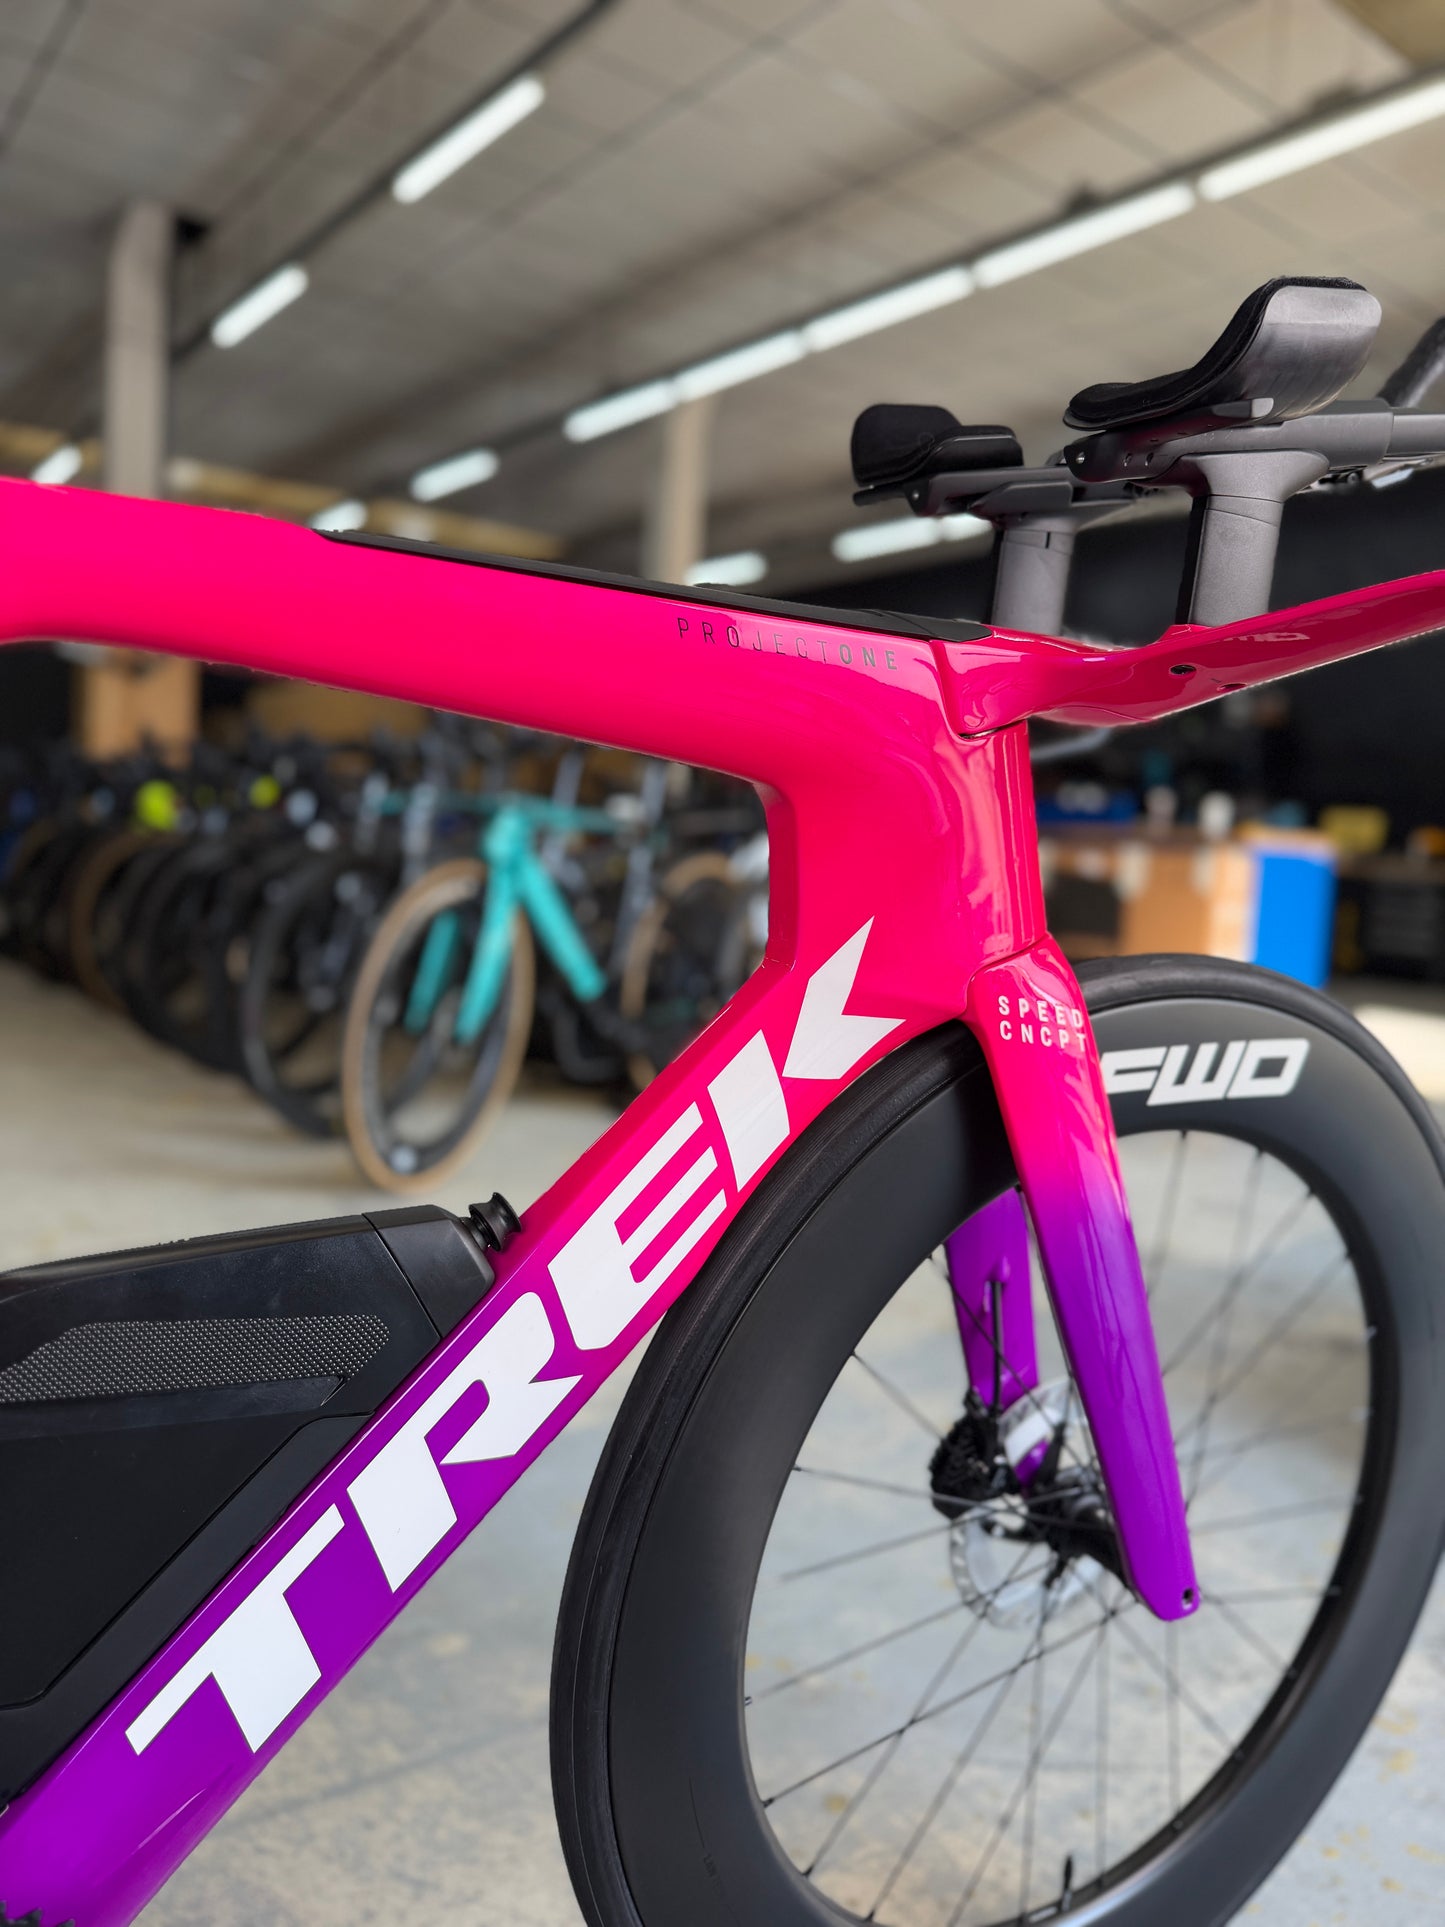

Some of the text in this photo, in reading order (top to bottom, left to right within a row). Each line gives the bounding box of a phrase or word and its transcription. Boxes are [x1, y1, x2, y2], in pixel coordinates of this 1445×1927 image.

[998, 995, 1084, 1028] SPEED
[1000, 1020, 1087, 1052] CNCPT
[125, 915, 906, 1755] TREK
